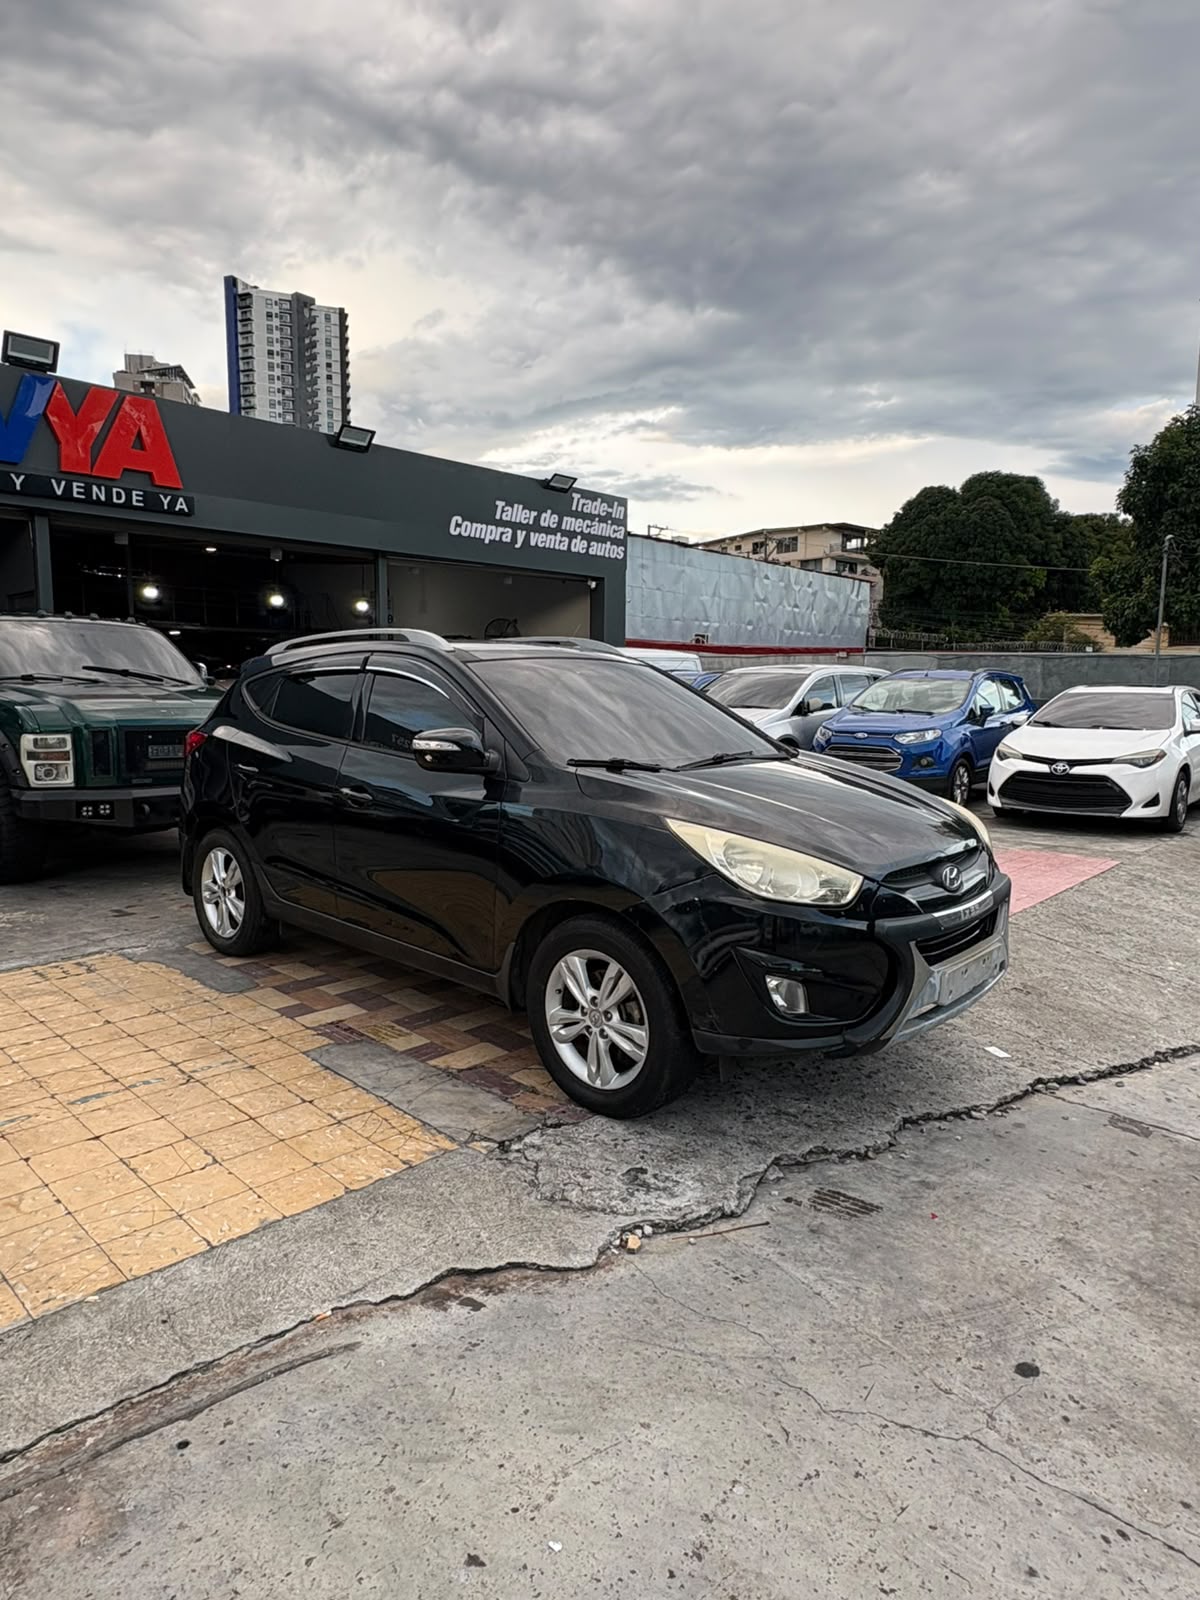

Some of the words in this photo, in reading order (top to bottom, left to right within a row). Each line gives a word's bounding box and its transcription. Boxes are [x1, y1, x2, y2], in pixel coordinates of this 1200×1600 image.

[10, 473, 26, 491] Y
[51, 478, 145, 507] VENDE
[159, 494, 189, 513] YA
[571, 492, 626, 520] Trade-In
[449, 515, 513, 545] Compra
[514, 529, 527, 549] y
[529, 531, 569, 552] venta
[570, 535, 588, 554] de
[588, 541, 626, 560] autos
[494, 500, 538, 526] Taller
[540, 509, 559, 529] de
[561, 515, 626, 540] mecánica
